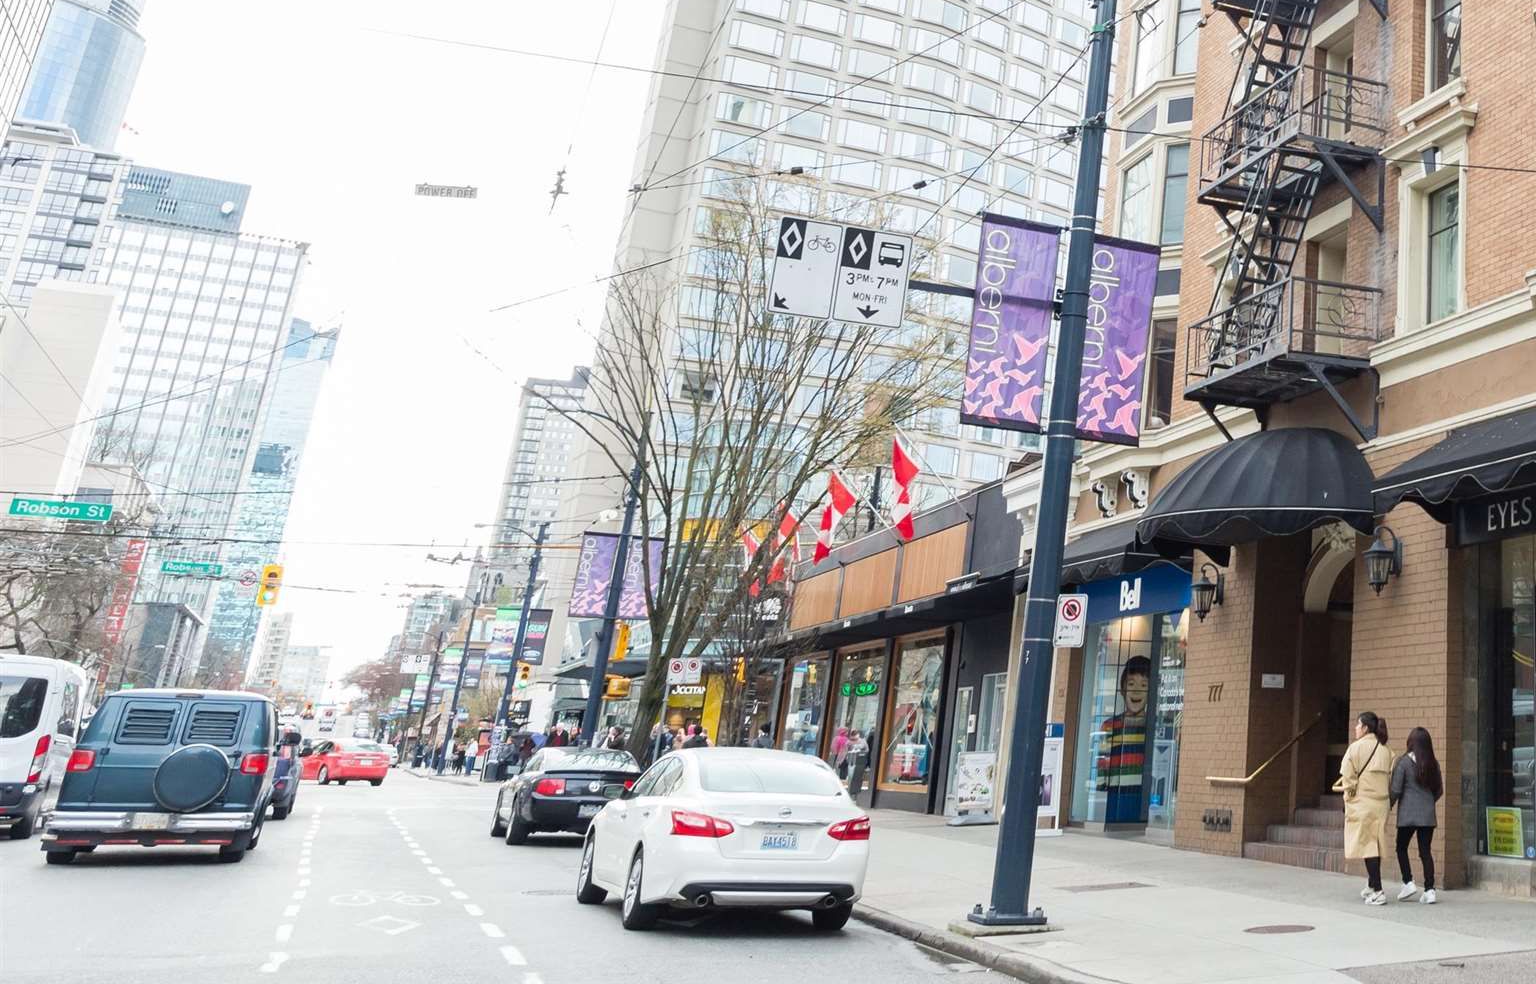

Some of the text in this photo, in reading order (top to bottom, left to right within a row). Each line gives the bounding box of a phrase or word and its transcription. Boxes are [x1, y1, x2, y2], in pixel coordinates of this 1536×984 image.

[417, 186, 475, 198] POWER OFF
[974, 230, 1017, 354] alberni
[1083, 250, 1121, 369] alberni
[16, 501, 105, 518] Robson St
[1487, 496, 1532, 532] EYES
[1119, 577, 1142, 612] Bell
[1208, 682, 1224, 703] 777
